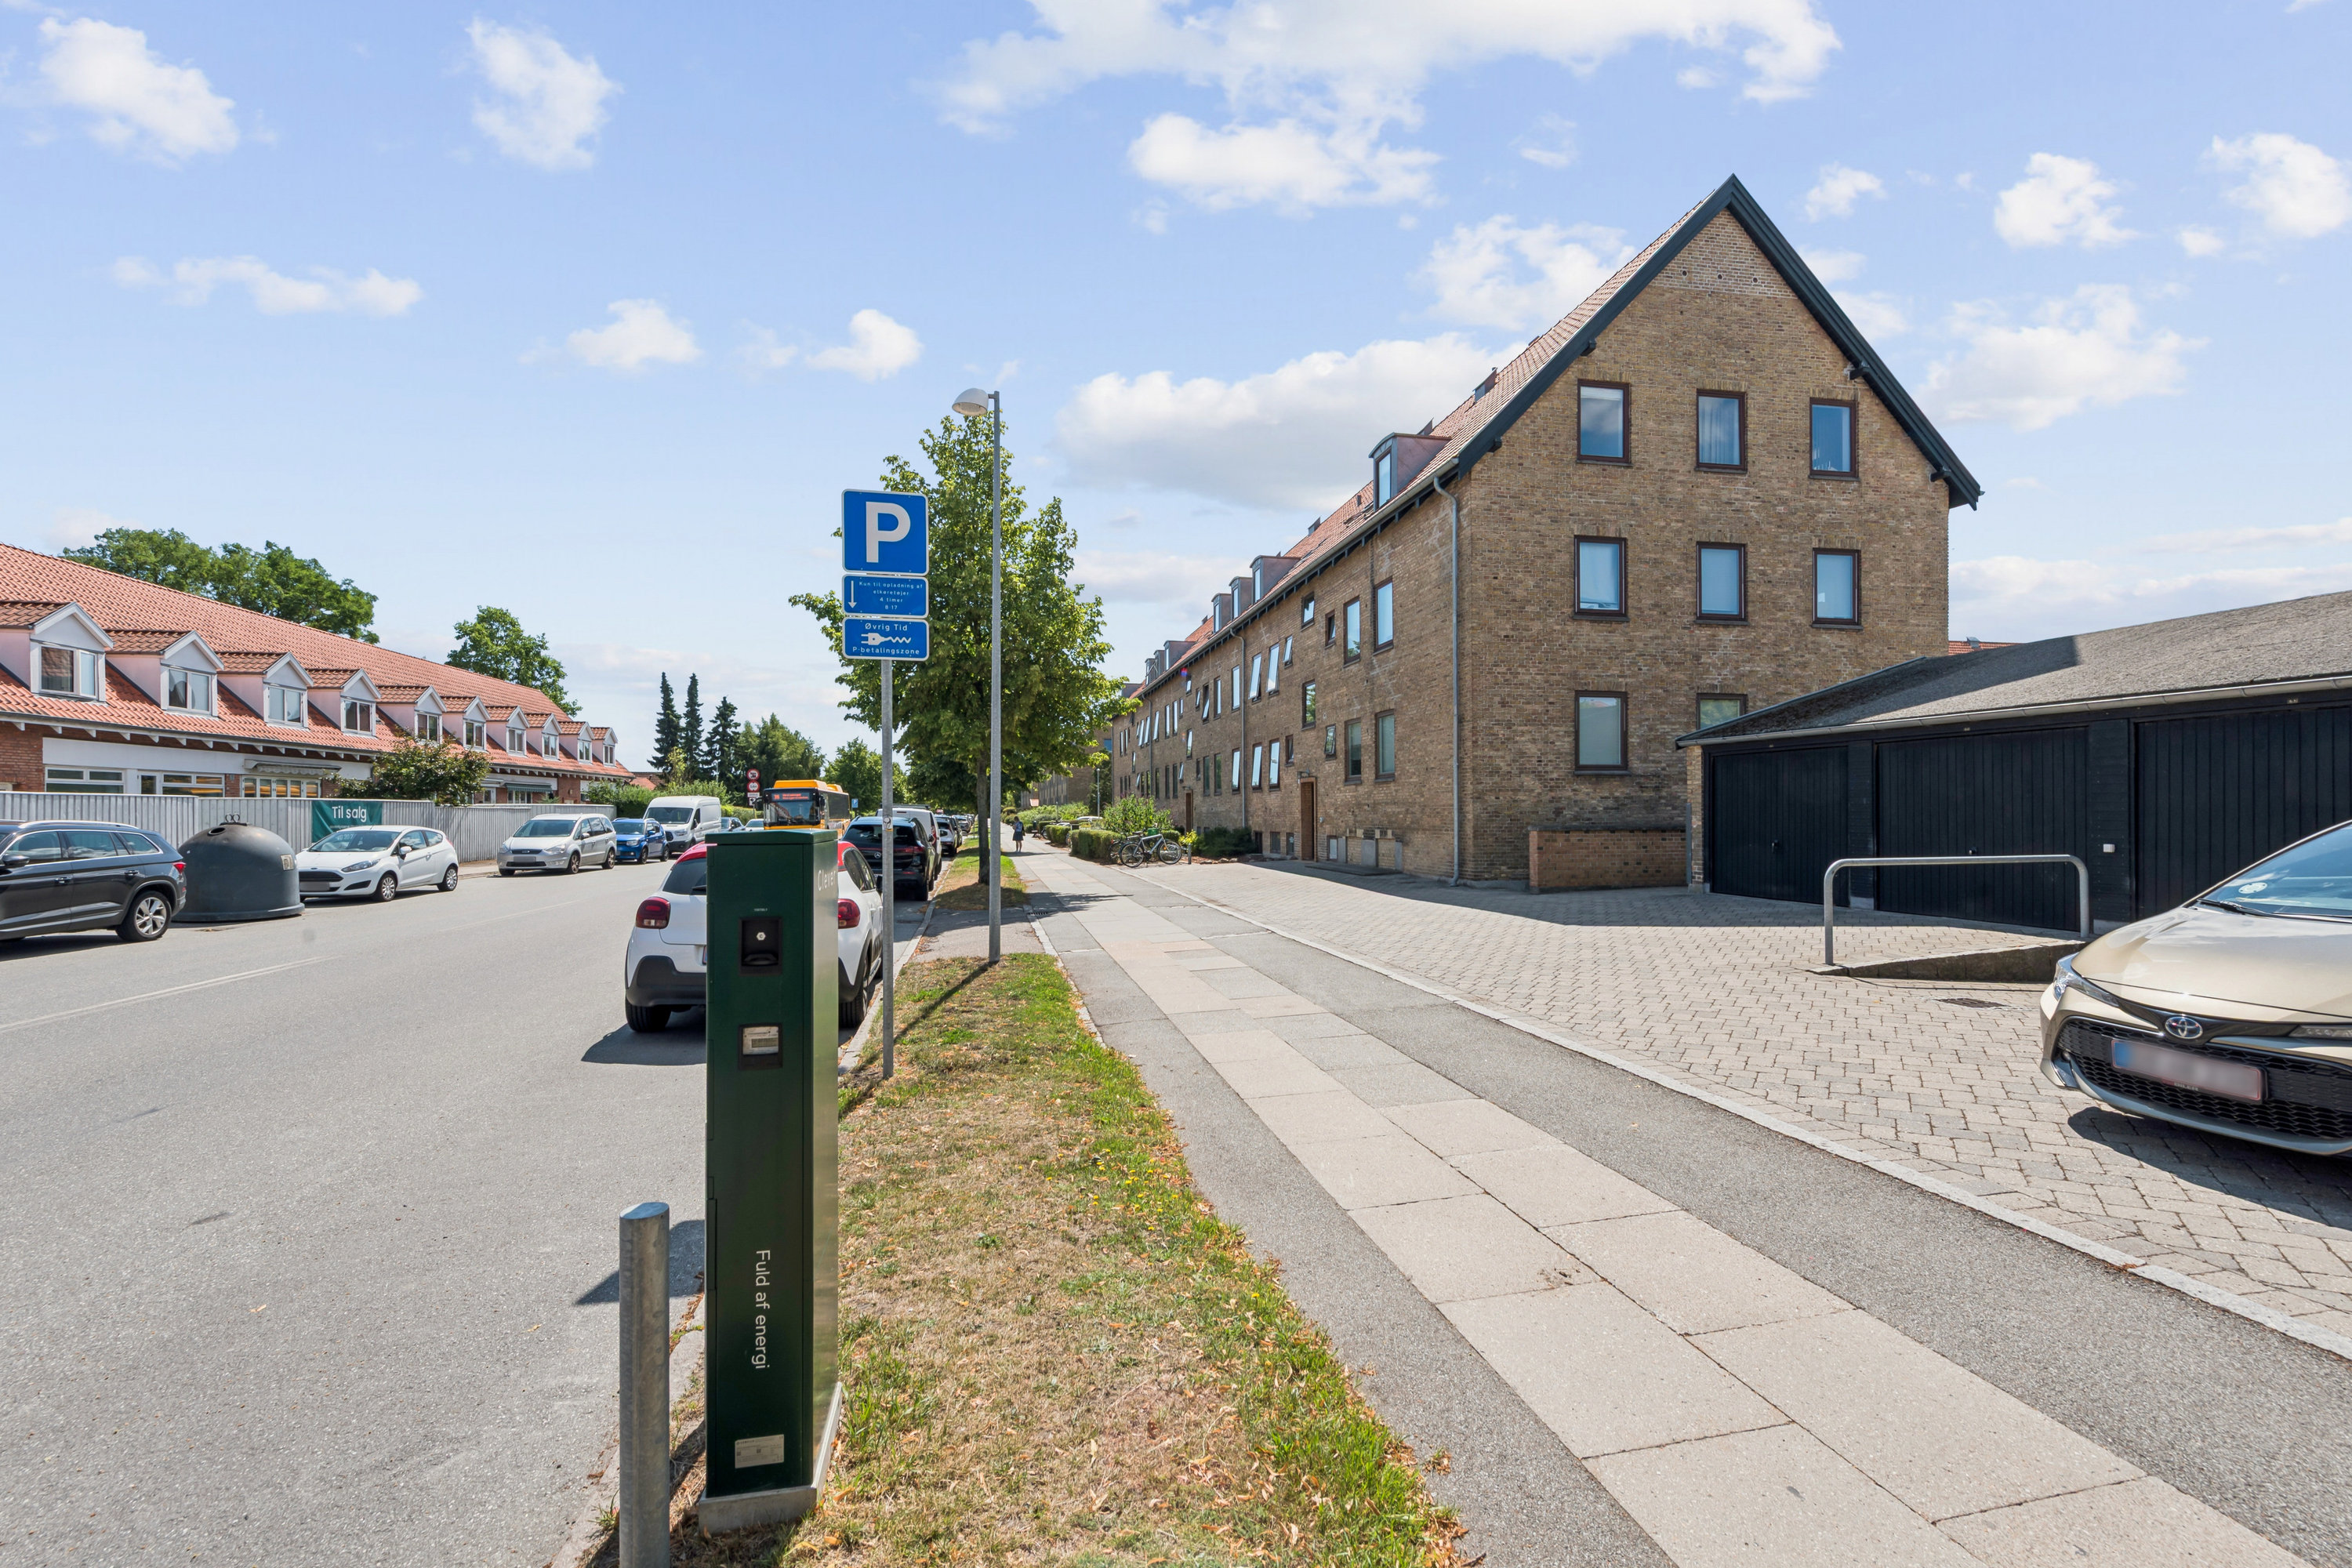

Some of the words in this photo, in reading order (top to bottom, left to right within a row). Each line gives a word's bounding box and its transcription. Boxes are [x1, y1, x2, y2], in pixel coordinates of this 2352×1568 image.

[866, 501, 911, 563] P
[865, 622, 890, 631] Øvrig
[852, 646, 920, 655] P-betalingszone
[332, 805, 343, 818] Til
[346, 805, 367, 822] salg
[817, 869, 837, 891] Clever
[755, 1249, 771, 1287] Fuld
[755, 1292, 771, 1309] af
[751, 1314, 771, 1369] energi
